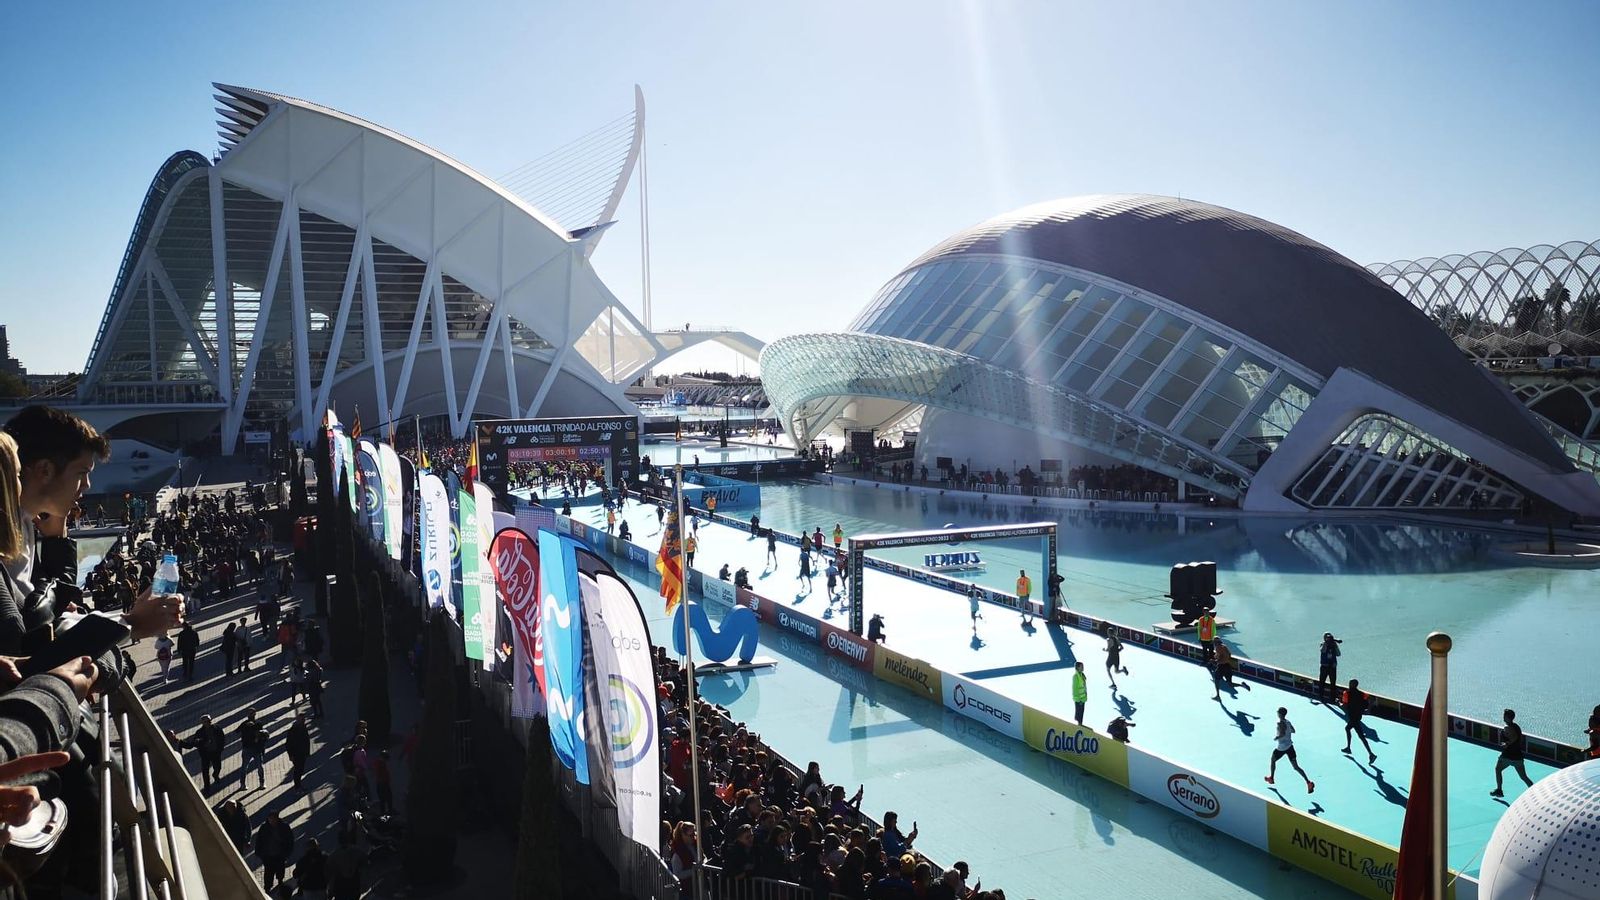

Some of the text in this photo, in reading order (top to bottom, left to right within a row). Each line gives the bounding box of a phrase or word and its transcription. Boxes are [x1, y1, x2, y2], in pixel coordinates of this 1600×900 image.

[496, 421, 622, 434] 42K VALENCIA TRINIDAD ALFONSO
[790, 618, 817, 639] HYUNDAI
[838, 635, 868, 662] ENERVIT
[885, 657, 929, 690] meléndez
[967, 697, 1012, 724] COROS
[1045, 728, 1099, 754] ColaCao
[1172, 780, 1216, 811] Serrano
[1291, 828, 1397, 880] AMSTEL Radle
